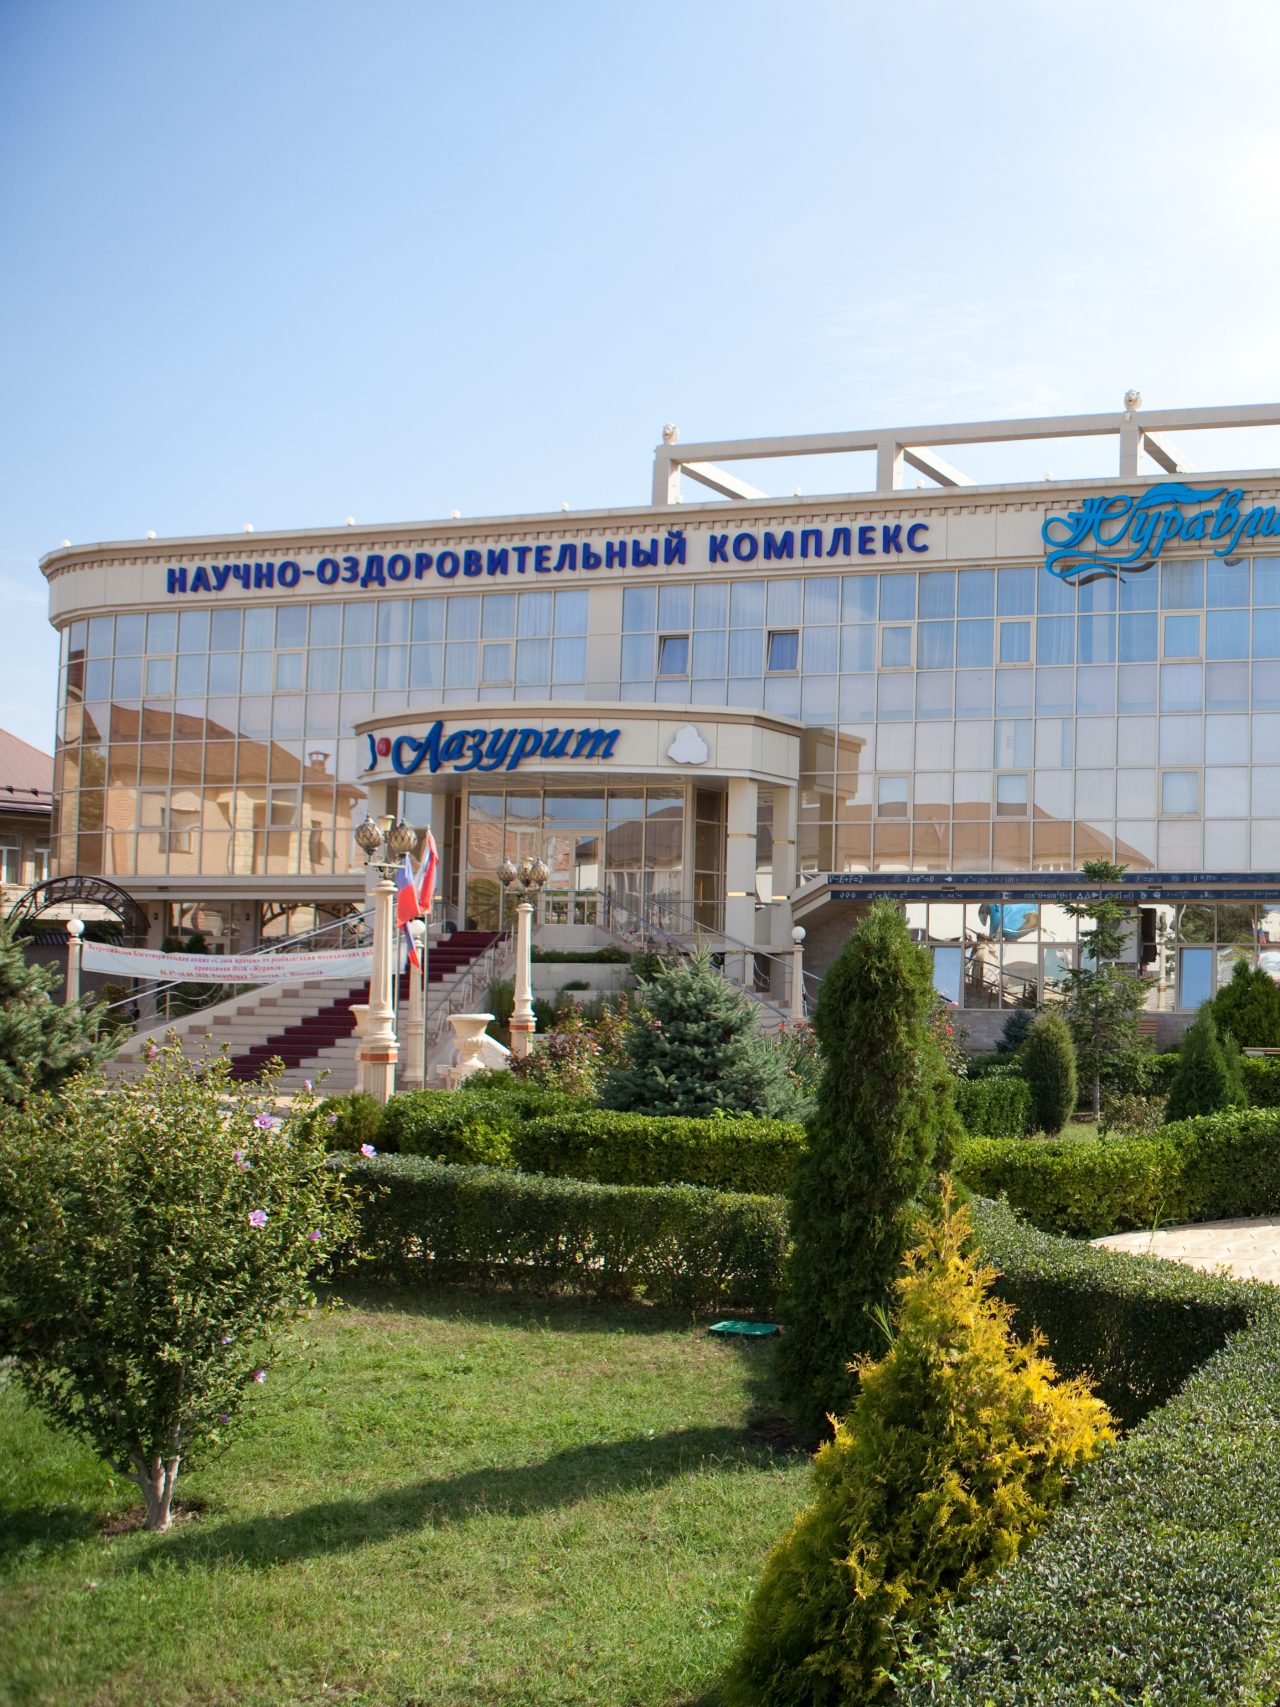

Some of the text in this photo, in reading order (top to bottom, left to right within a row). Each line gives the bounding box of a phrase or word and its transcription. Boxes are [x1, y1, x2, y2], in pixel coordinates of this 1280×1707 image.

[166, 522, 930, 594] НАУЧНО-ОЗДОРОВИТЕЛЬНЫЙ КОМПЛЕКС
[391, 719, 622, 776] Лазурит
